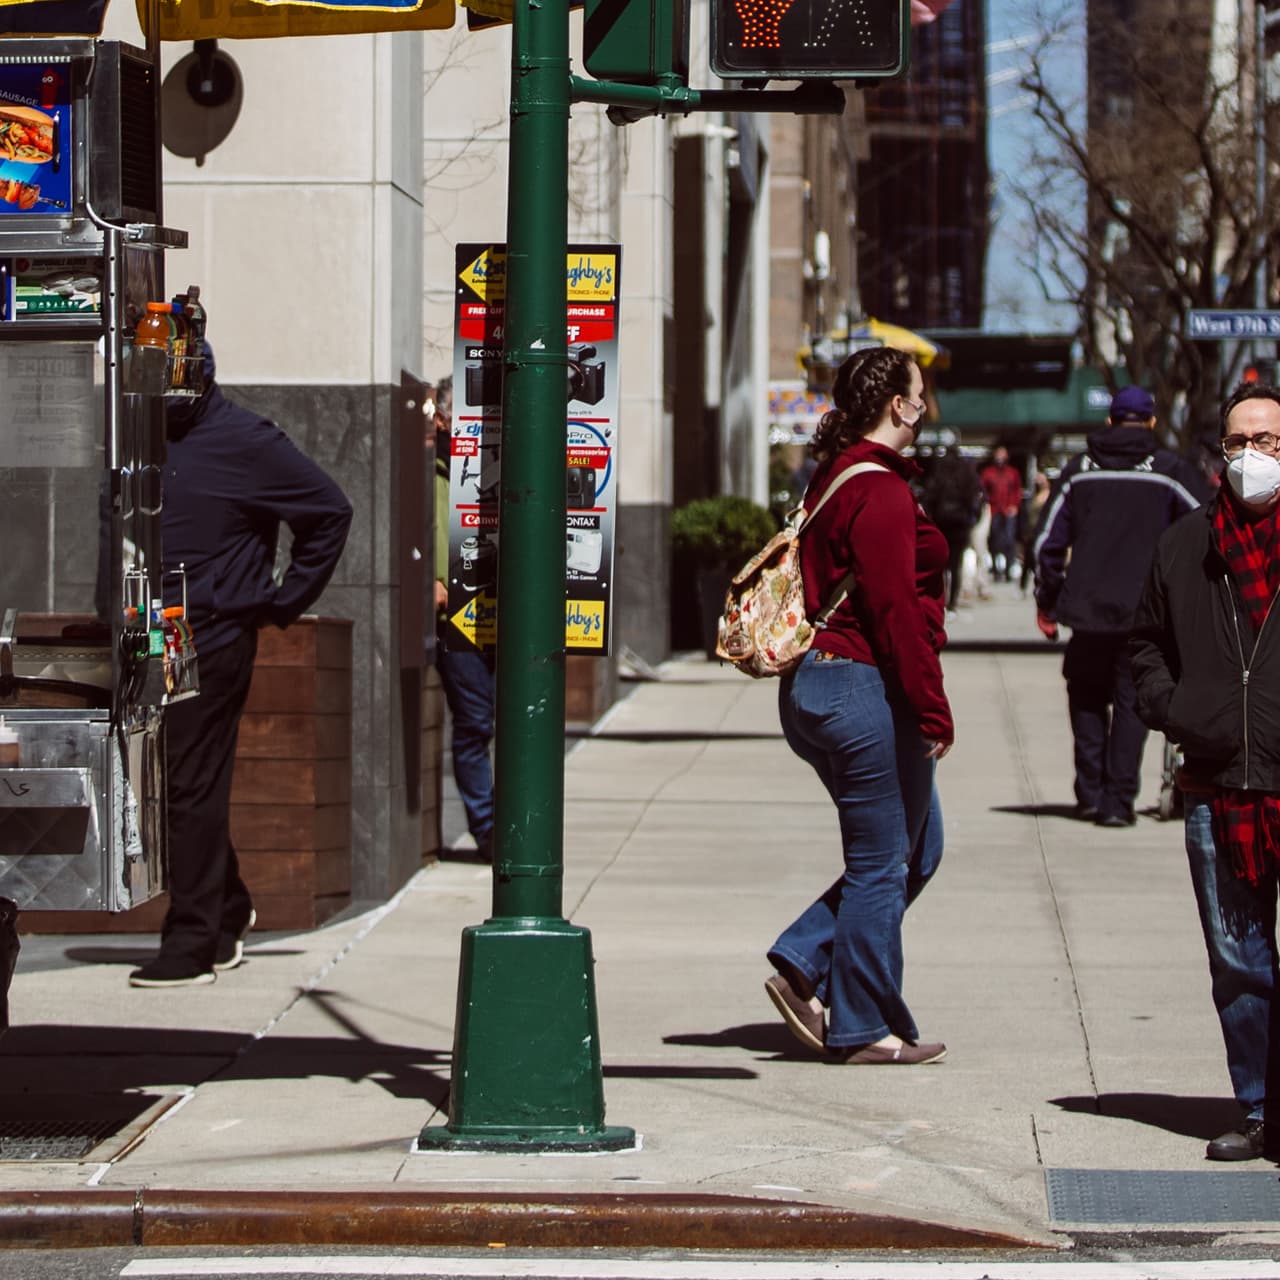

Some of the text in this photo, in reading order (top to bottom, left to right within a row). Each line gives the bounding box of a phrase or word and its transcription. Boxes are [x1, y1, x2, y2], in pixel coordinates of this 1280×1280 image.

[567, 308, 606, 316] URCHASE
[469, 349, 503, 358] SONY
[466, 423, 485, 436] dji
[567, 431, 593, 439] Pro
[568, 456, 590, 465] SALE!
[566, 516, 595, 526] ONTAX
